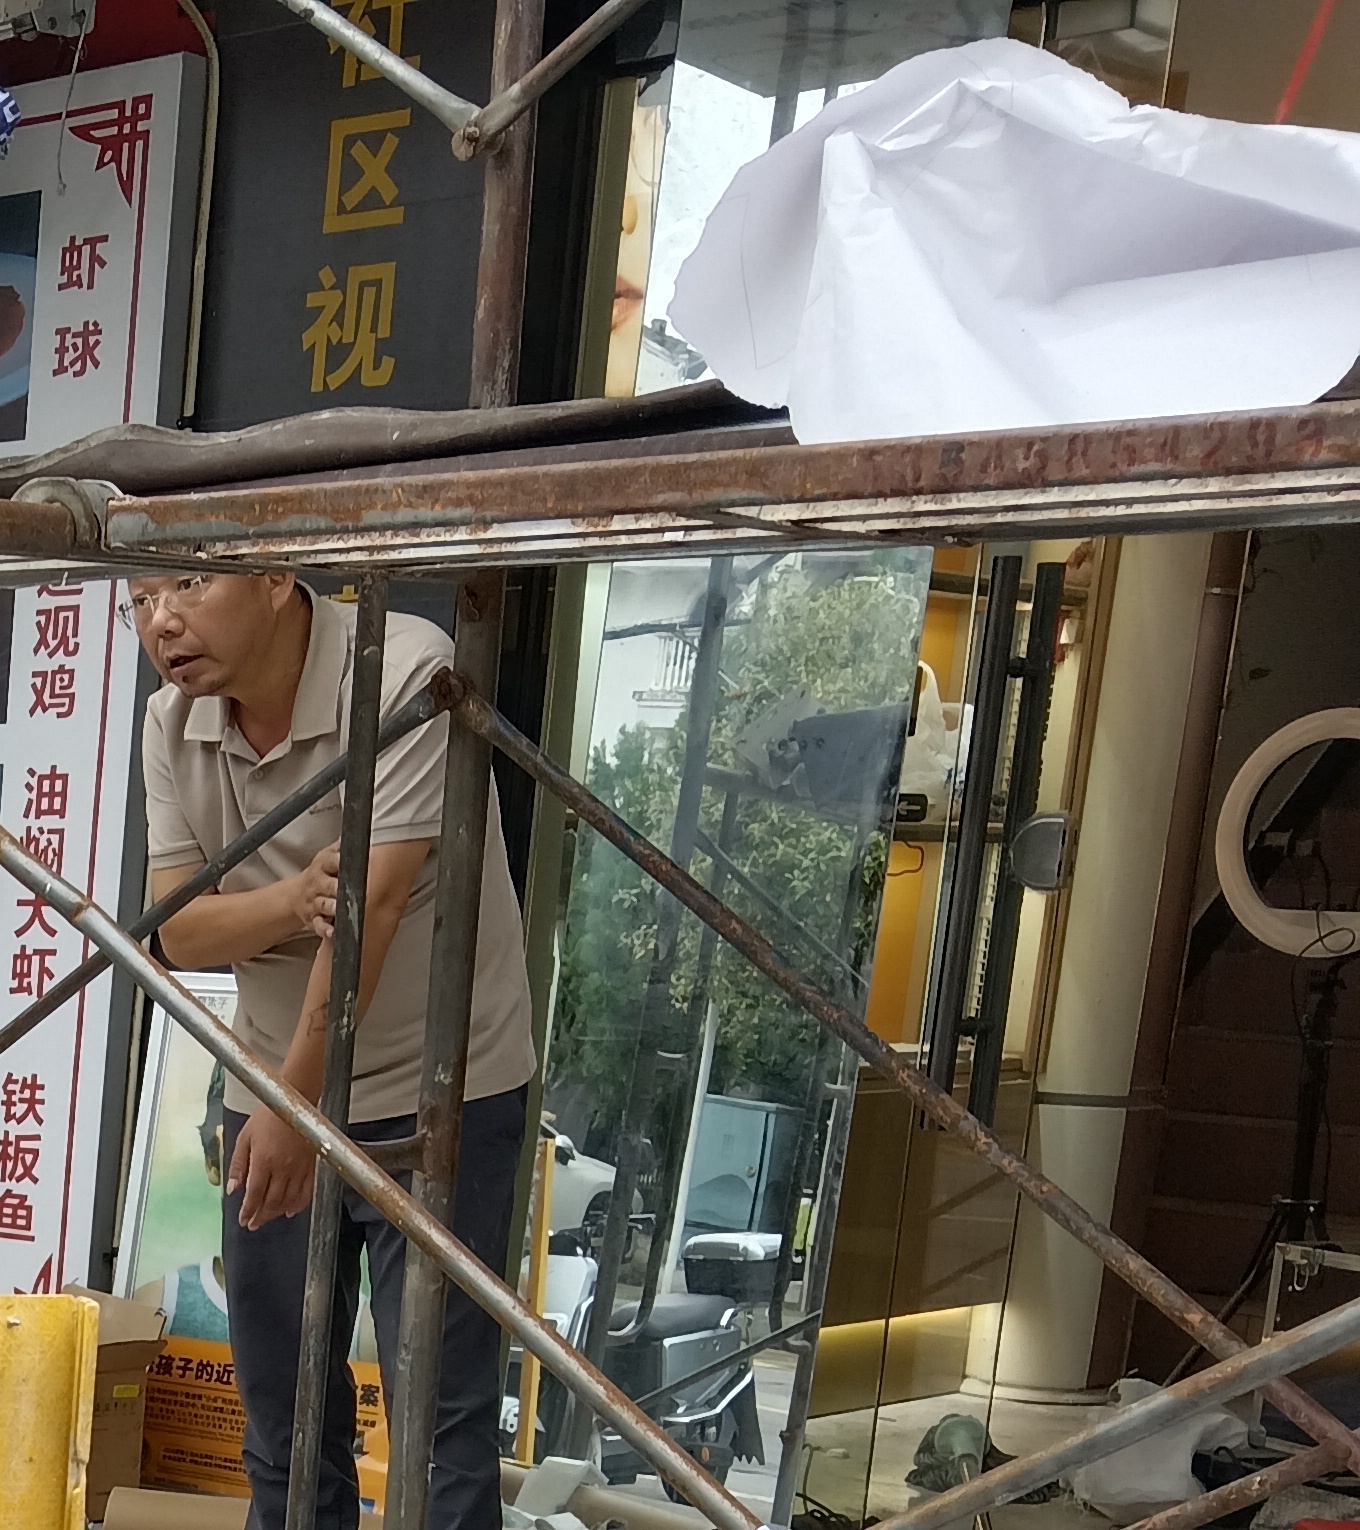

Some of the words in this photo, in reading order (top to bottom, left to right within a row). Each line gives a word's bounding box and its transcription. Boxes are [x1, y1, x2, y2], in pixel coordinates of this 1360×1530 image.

[52, 234, 111, 379] 虾球
[28, 583, 85, 720] 观鸡
[147, 1353, 235, 1387] 孩子的近
